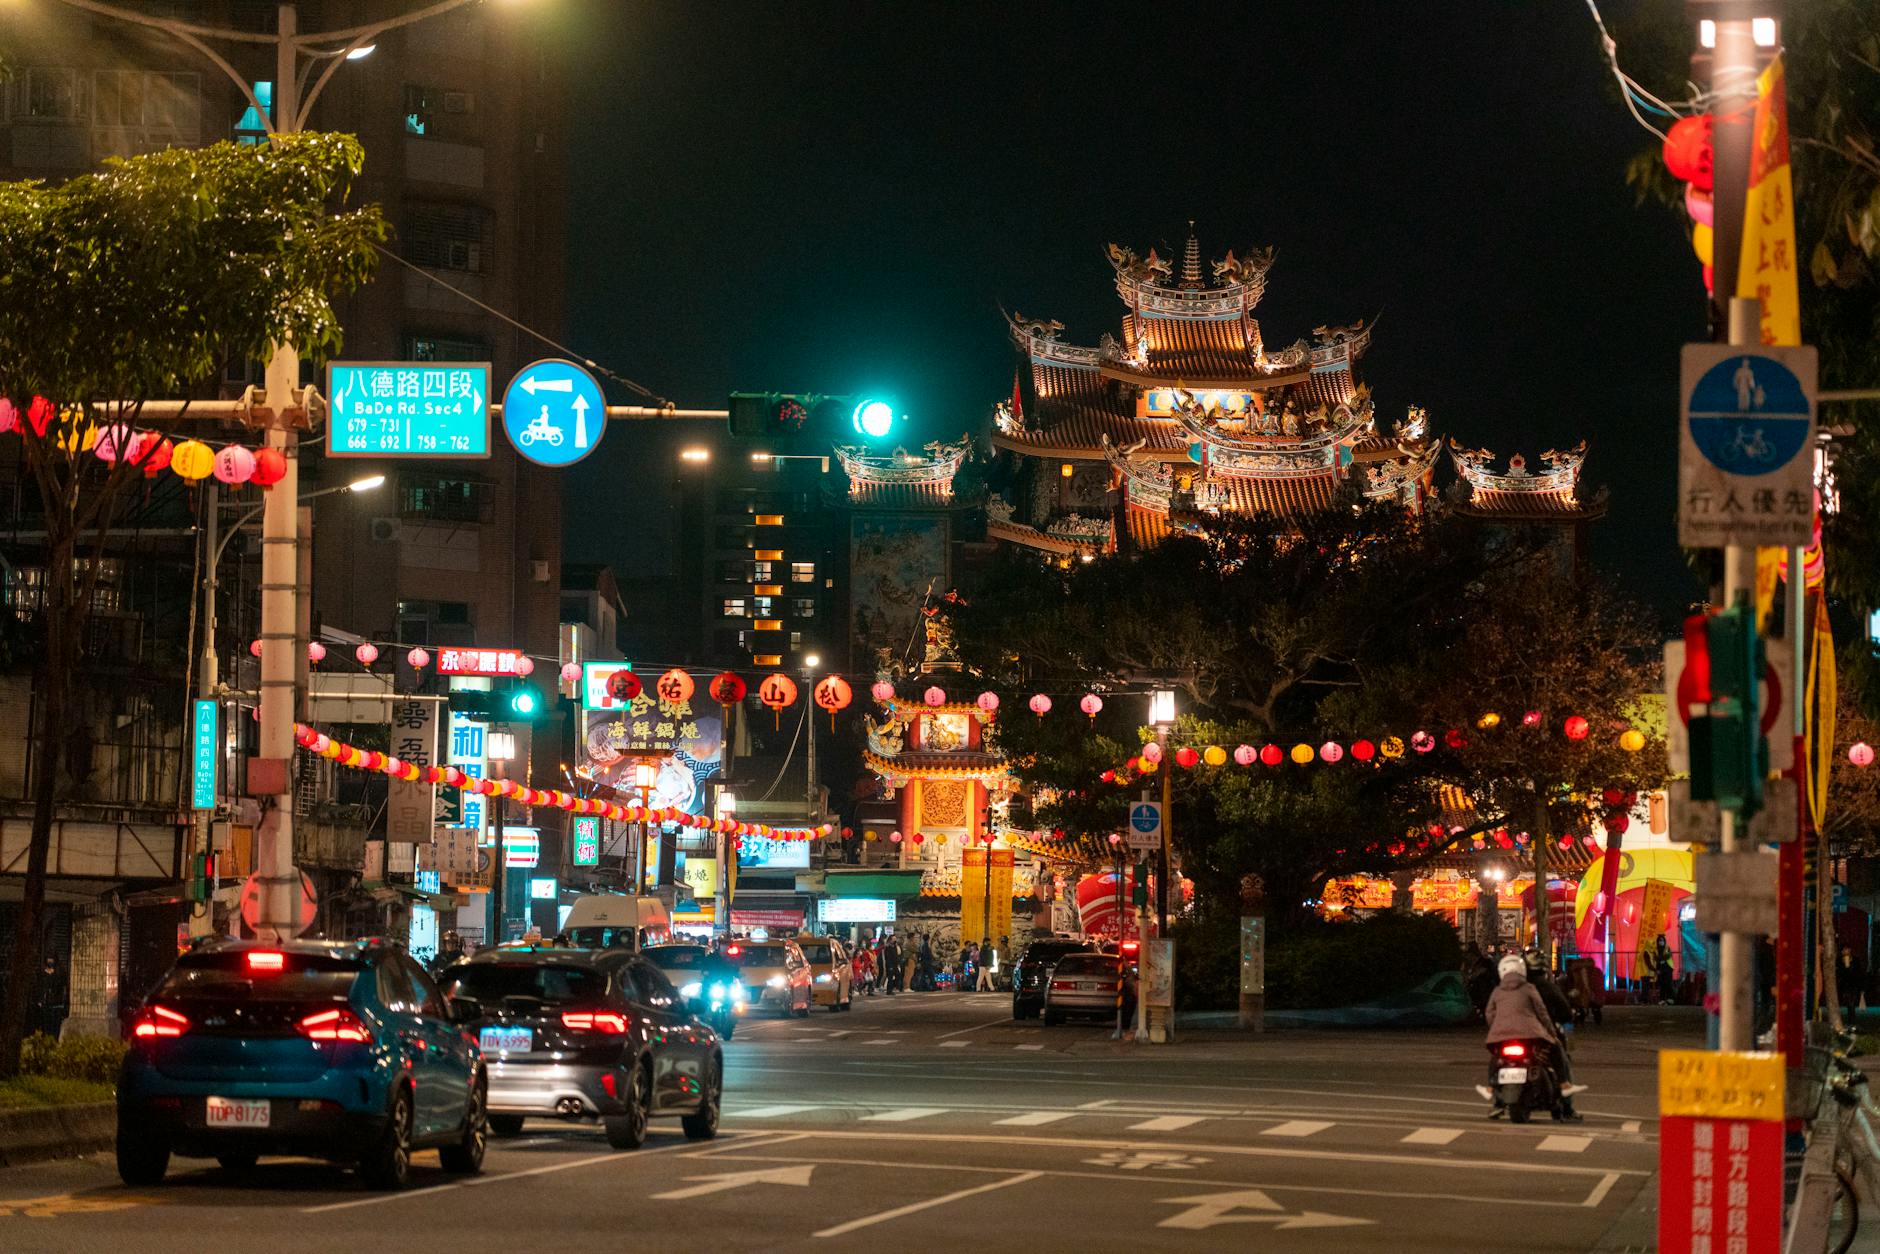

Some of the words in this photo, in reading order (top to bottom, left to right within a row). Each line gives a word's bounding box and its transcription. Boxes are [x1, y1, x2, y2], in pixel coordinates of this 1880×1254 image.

[344, 370, 473, 399] 八德路四段
[354, 402, 393, 415] BaDe
[398, 402, 420, 415] Rd.
[1688, 489, 1809, 514] 行人優先
[764, 682, 785, 703] 山
[818, 684, 841, 707] 松
[199, 711, 210, 770] 八德路四段
[607, 720, 701, 741] 海鮮鍋燒
